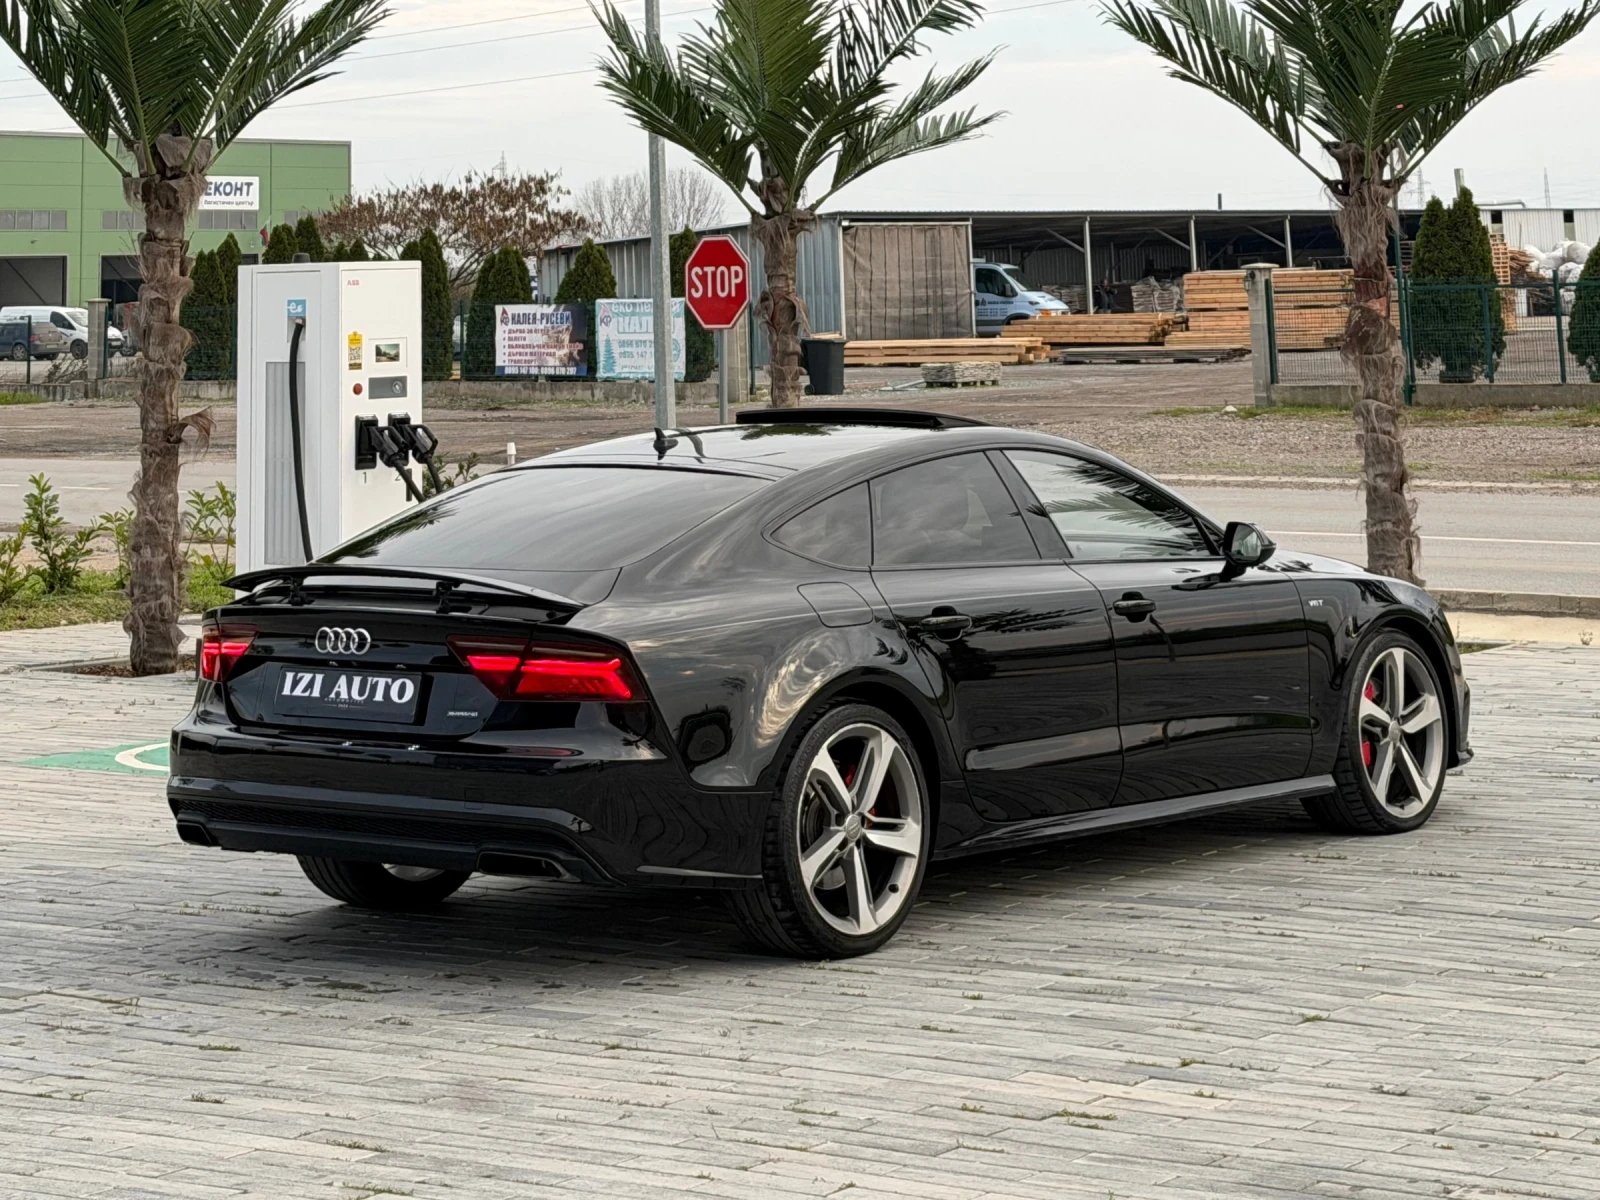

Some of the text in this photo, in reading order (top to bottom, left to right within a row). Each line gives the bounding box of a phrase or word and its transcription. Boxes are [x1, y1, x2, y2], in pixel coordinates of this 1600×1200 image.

[204, 181, 254, 197] ЕКОНТ
[690, 265, 744, 299] STOP
[511, 311, 572, 326] КАЛЕЯ-РУСЕВИ
[362, 471, 367, 484] 1
[281, 671, 415, 704] IZI AUTO
